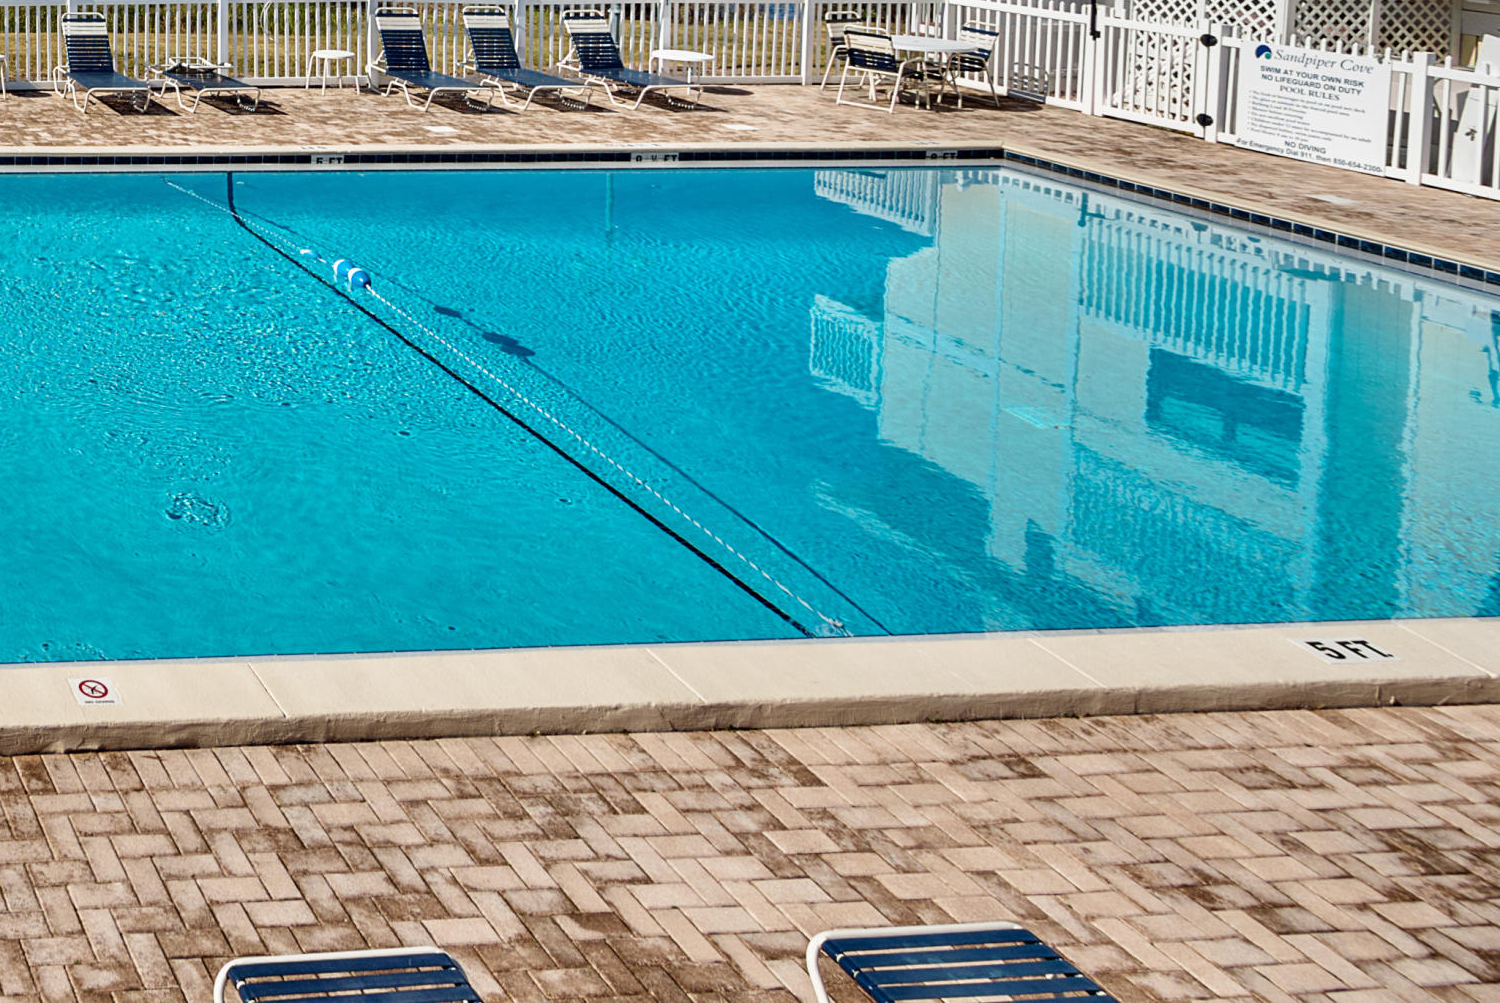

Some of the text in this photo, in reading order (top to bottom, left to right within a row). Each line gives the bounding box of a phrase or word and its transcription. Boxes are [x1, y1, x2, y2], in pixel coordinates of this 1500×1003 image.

[1274, 49, 1374, 74] Sandpiper Cove
[1260, 65, 1281, 74] SWIM
[1296, 71, 1319, 80] YOUR
[1321, 75, 1341, 84] OWN
[1344, 79, 1364, 88] RISK
[1261, 73, 1362, 96] NO LIFEGUARD ON DUTY
[1280, 85, 1340, 101] POOL RULES
[1284, 140, 1327, 154] NO DIVING
[1305, 641, 1347, 660] 5
